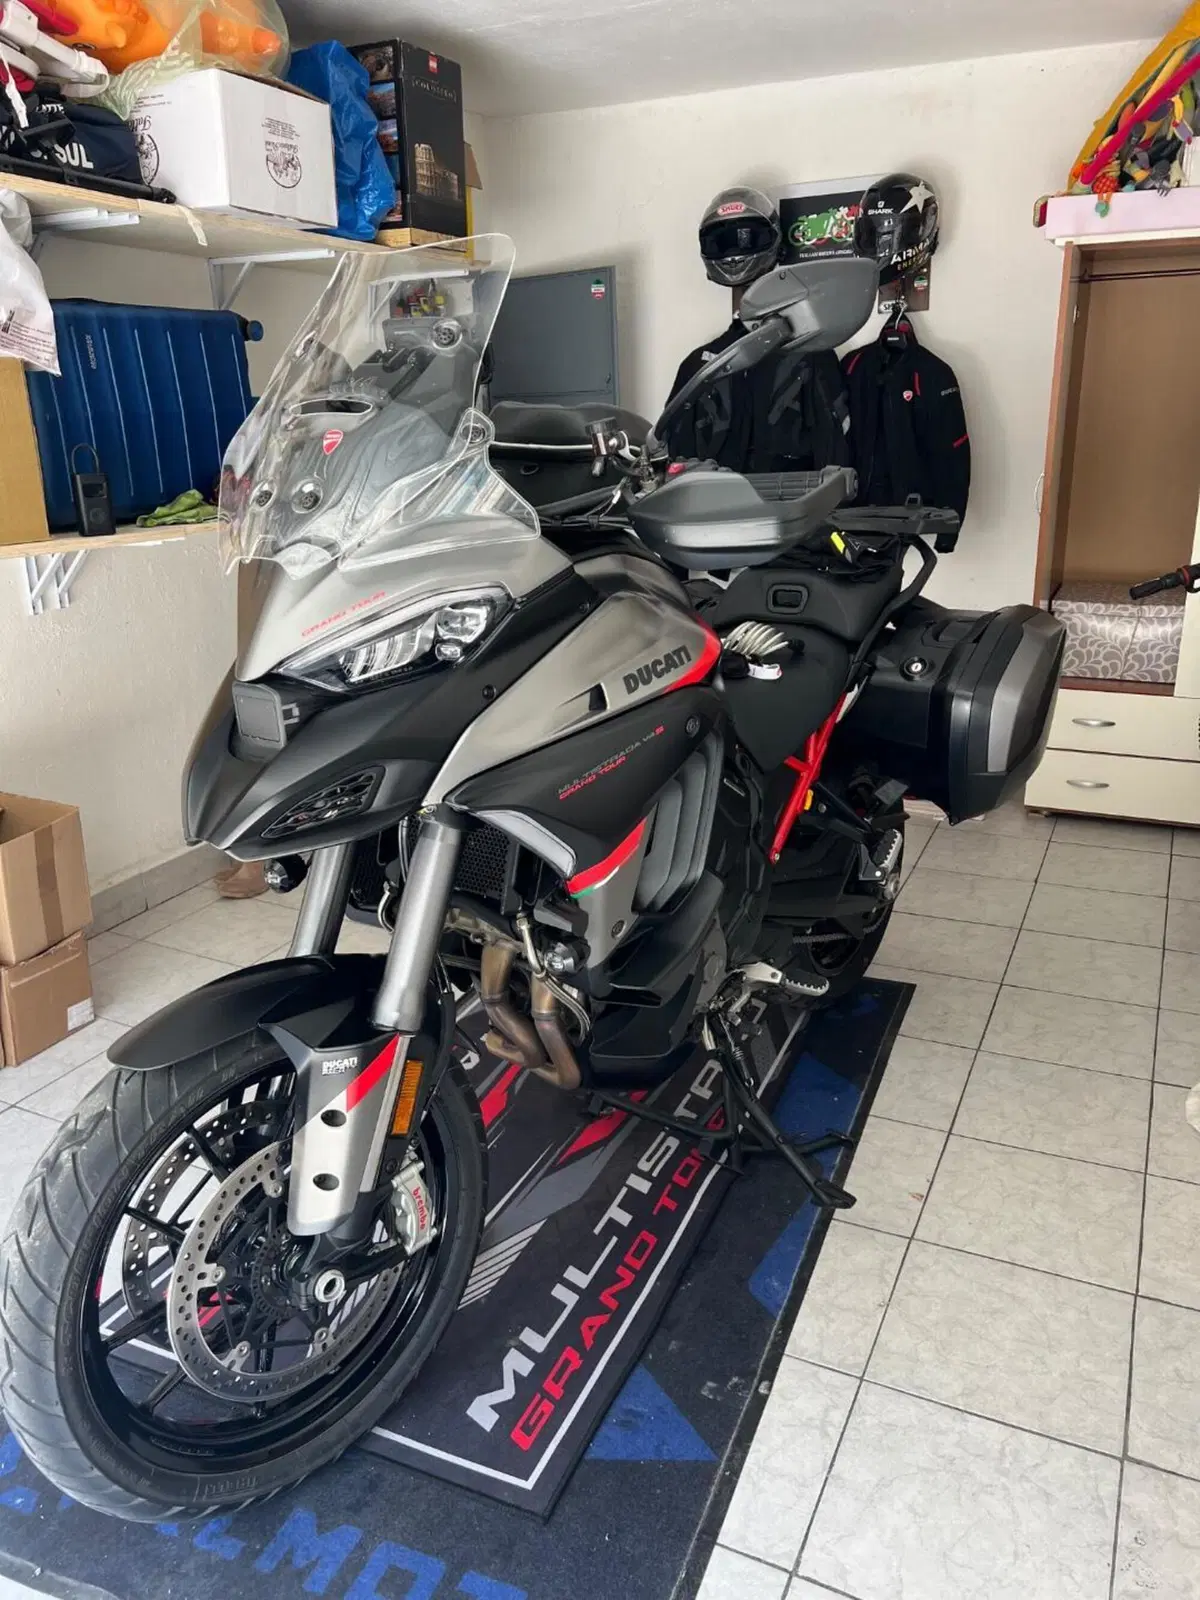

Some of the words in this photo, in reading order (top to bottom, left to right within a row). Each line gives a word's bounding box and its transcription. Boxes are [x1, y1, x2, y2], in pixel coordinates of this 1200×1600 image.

[867, 207, 894, 215] SHARK
[622, 645, 692, 695] DUCATI
[558, 774, 597, 801] GRAND
[599, 755, 627, 775] TOUR
[321, 1056, 358, 1070] DUCATI
[412, 1186, 425, 1231] brembo
[509, 1230, 660, 1452] GRAND
